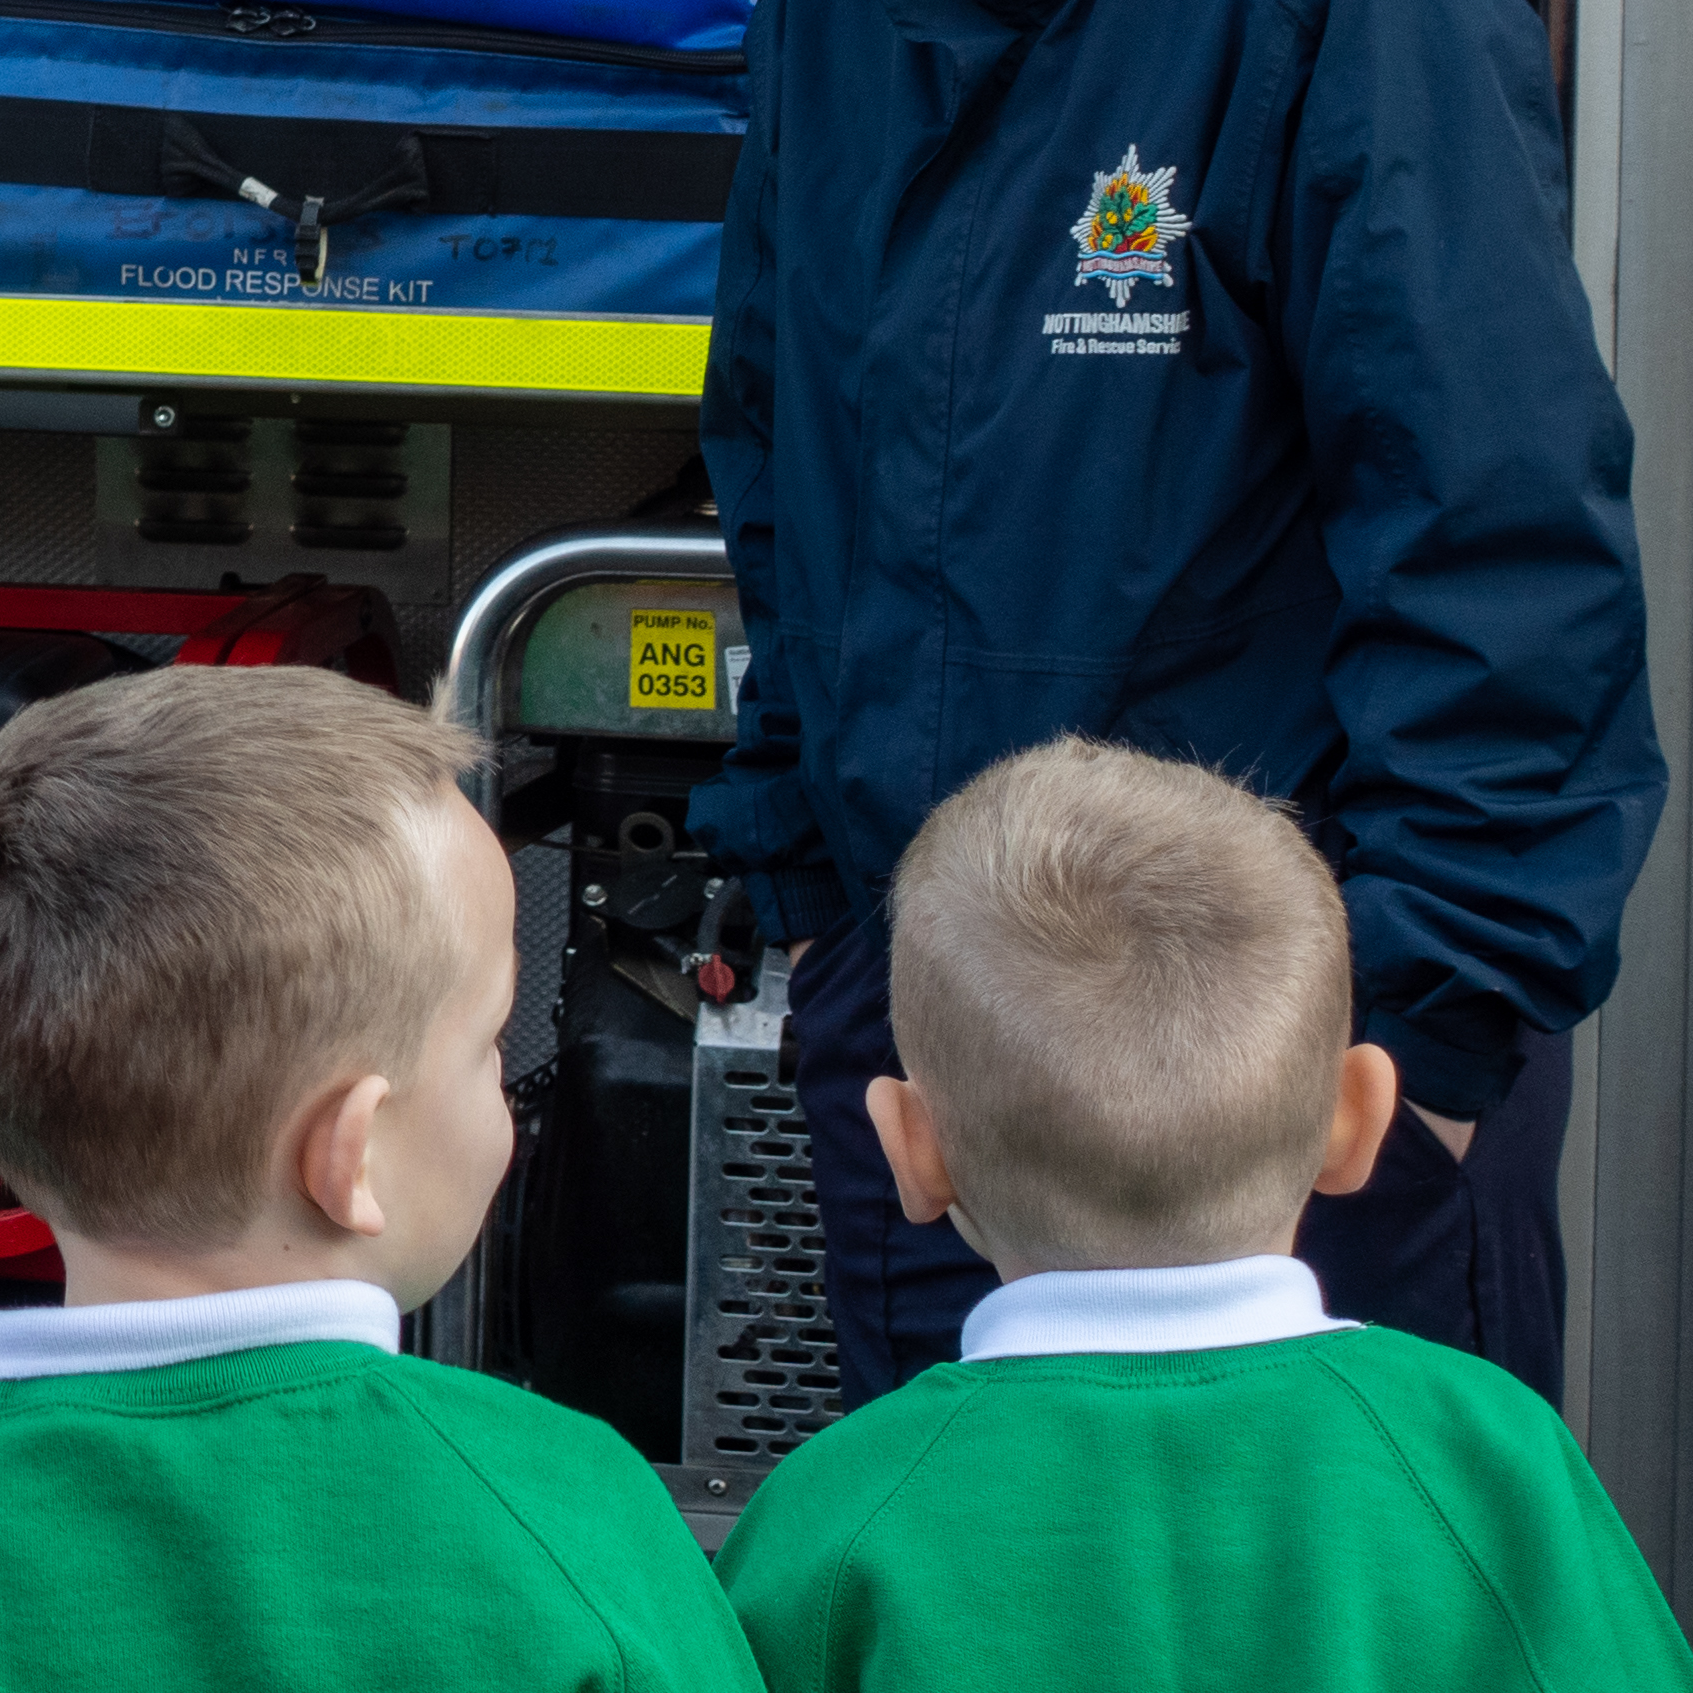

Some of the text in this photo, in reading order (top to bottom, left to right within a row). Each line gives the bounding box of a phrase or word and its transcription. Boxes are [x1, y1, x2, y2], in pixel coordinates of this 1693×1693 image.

[120, 262, 217, 291] FLOOD
[388, 279, 433, 303] KIT
[1051, 338, 1075, 355] Fire
[1076, 337, 1087, 354] &
[1088, 338, 1135, 354] Rescue
[633, 614, 712, 630] PUMP No.
[638, 642, 706, 667] ANG
[638, 673, 707, 698] 0353
